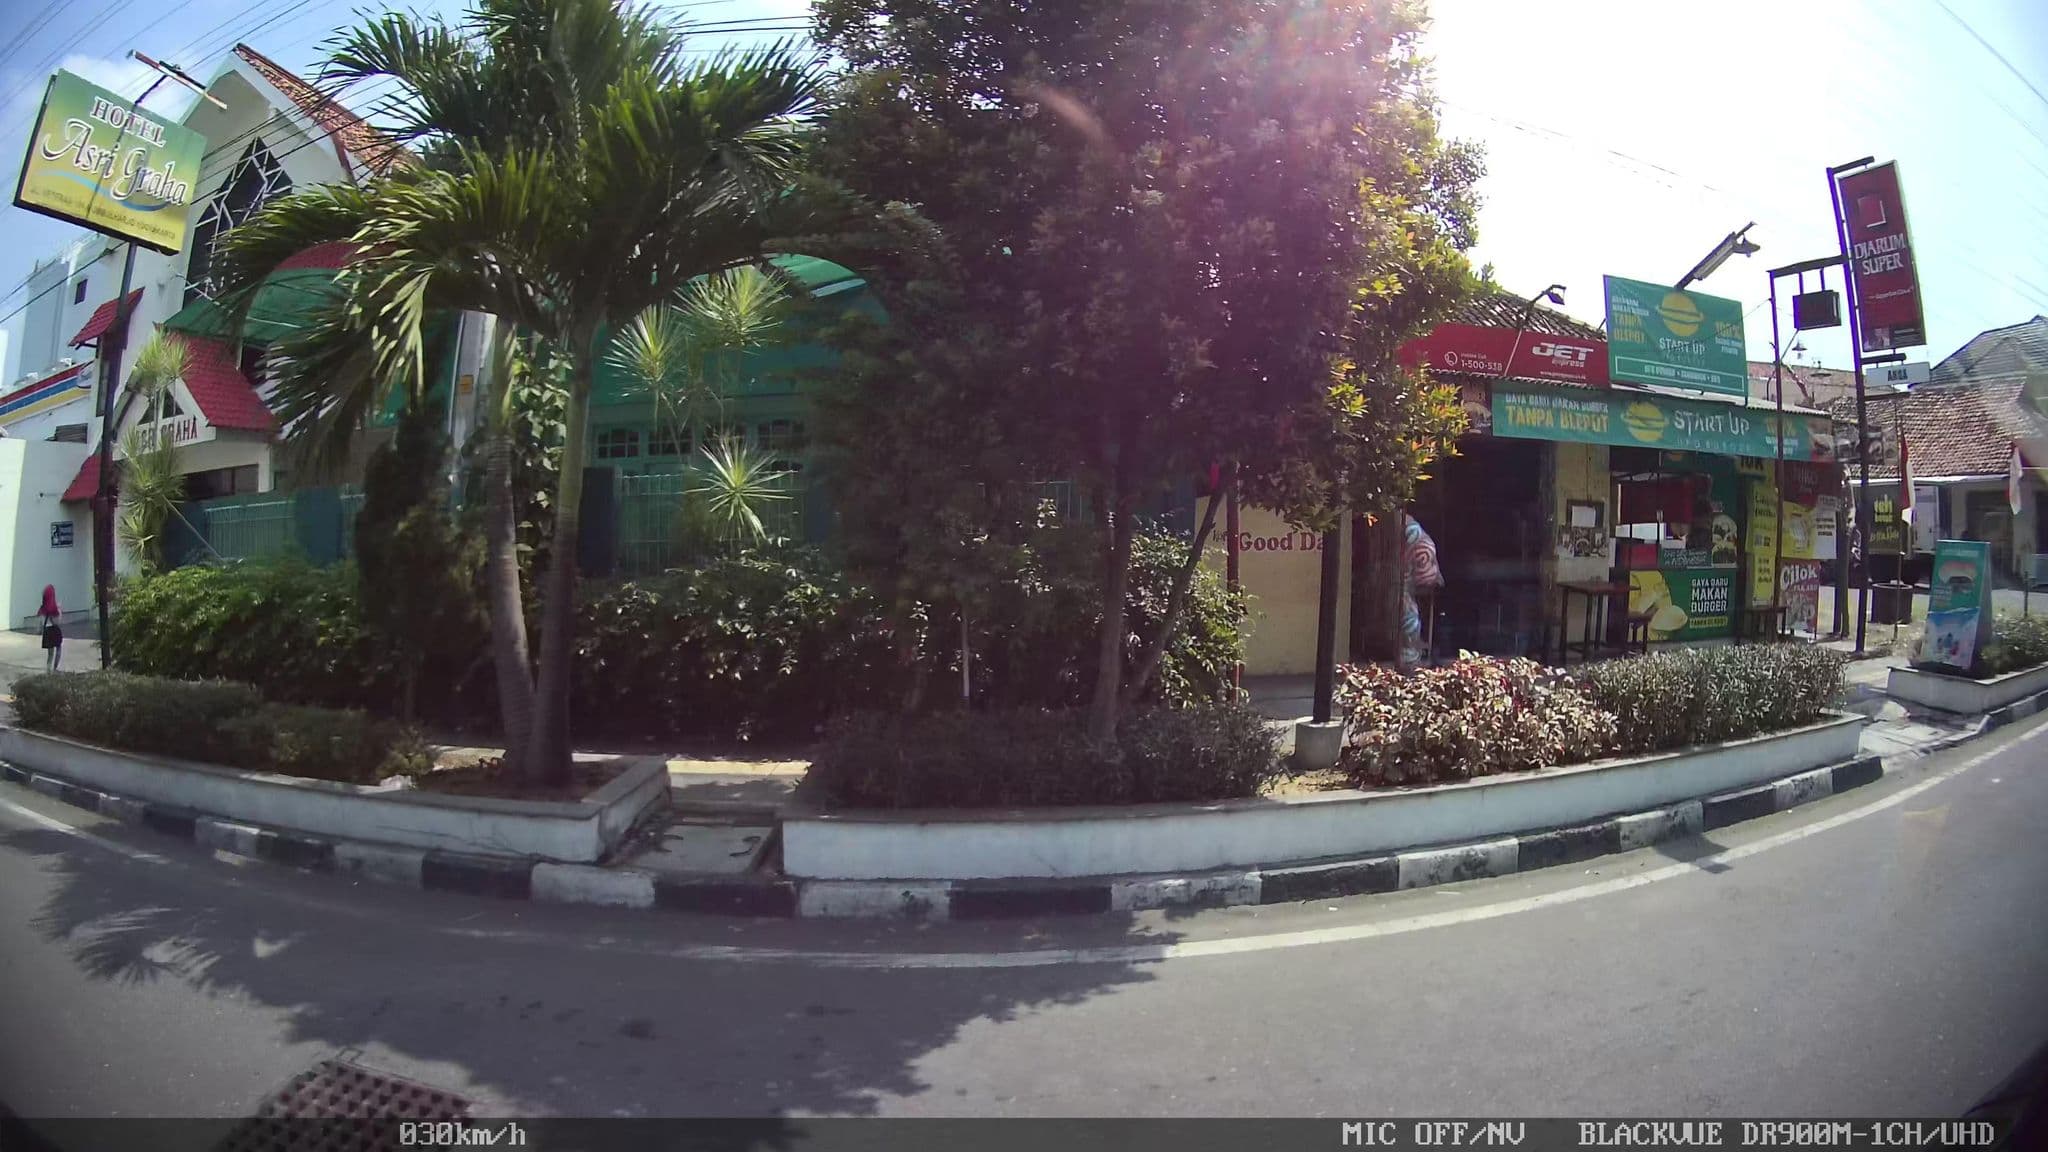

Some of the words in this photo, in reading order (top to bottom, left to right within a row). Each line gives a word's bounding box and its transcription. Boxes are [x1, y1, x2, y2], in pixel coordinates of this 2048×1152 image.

[90, 96, 166, 148] HOTEL
[42, 118, 118, 179] Asri
[110, 147, 188, 206] Graha
[1854, 233, 1906, 260] DJARUM
[1862, 252, 1904, 276] SUPER
[1532, 342, 1594, 361] JET
[1659, 337, 1690, 353] START
[1692, 340, 1705, 355] UP
[1505, 405, 1554, 428] TANPA
[1673, 410, 1724, 436] START
[1728, 411, 1750, 436] UP
[1239, 532, 1293, 551] Good
[1300, 531, 1324, 551] Da
[1780, 564, 1818, 591] Cilok
[1691, 587, 1728, 600] MAKAN
[1691, 600, 1727, 613] BURGER
